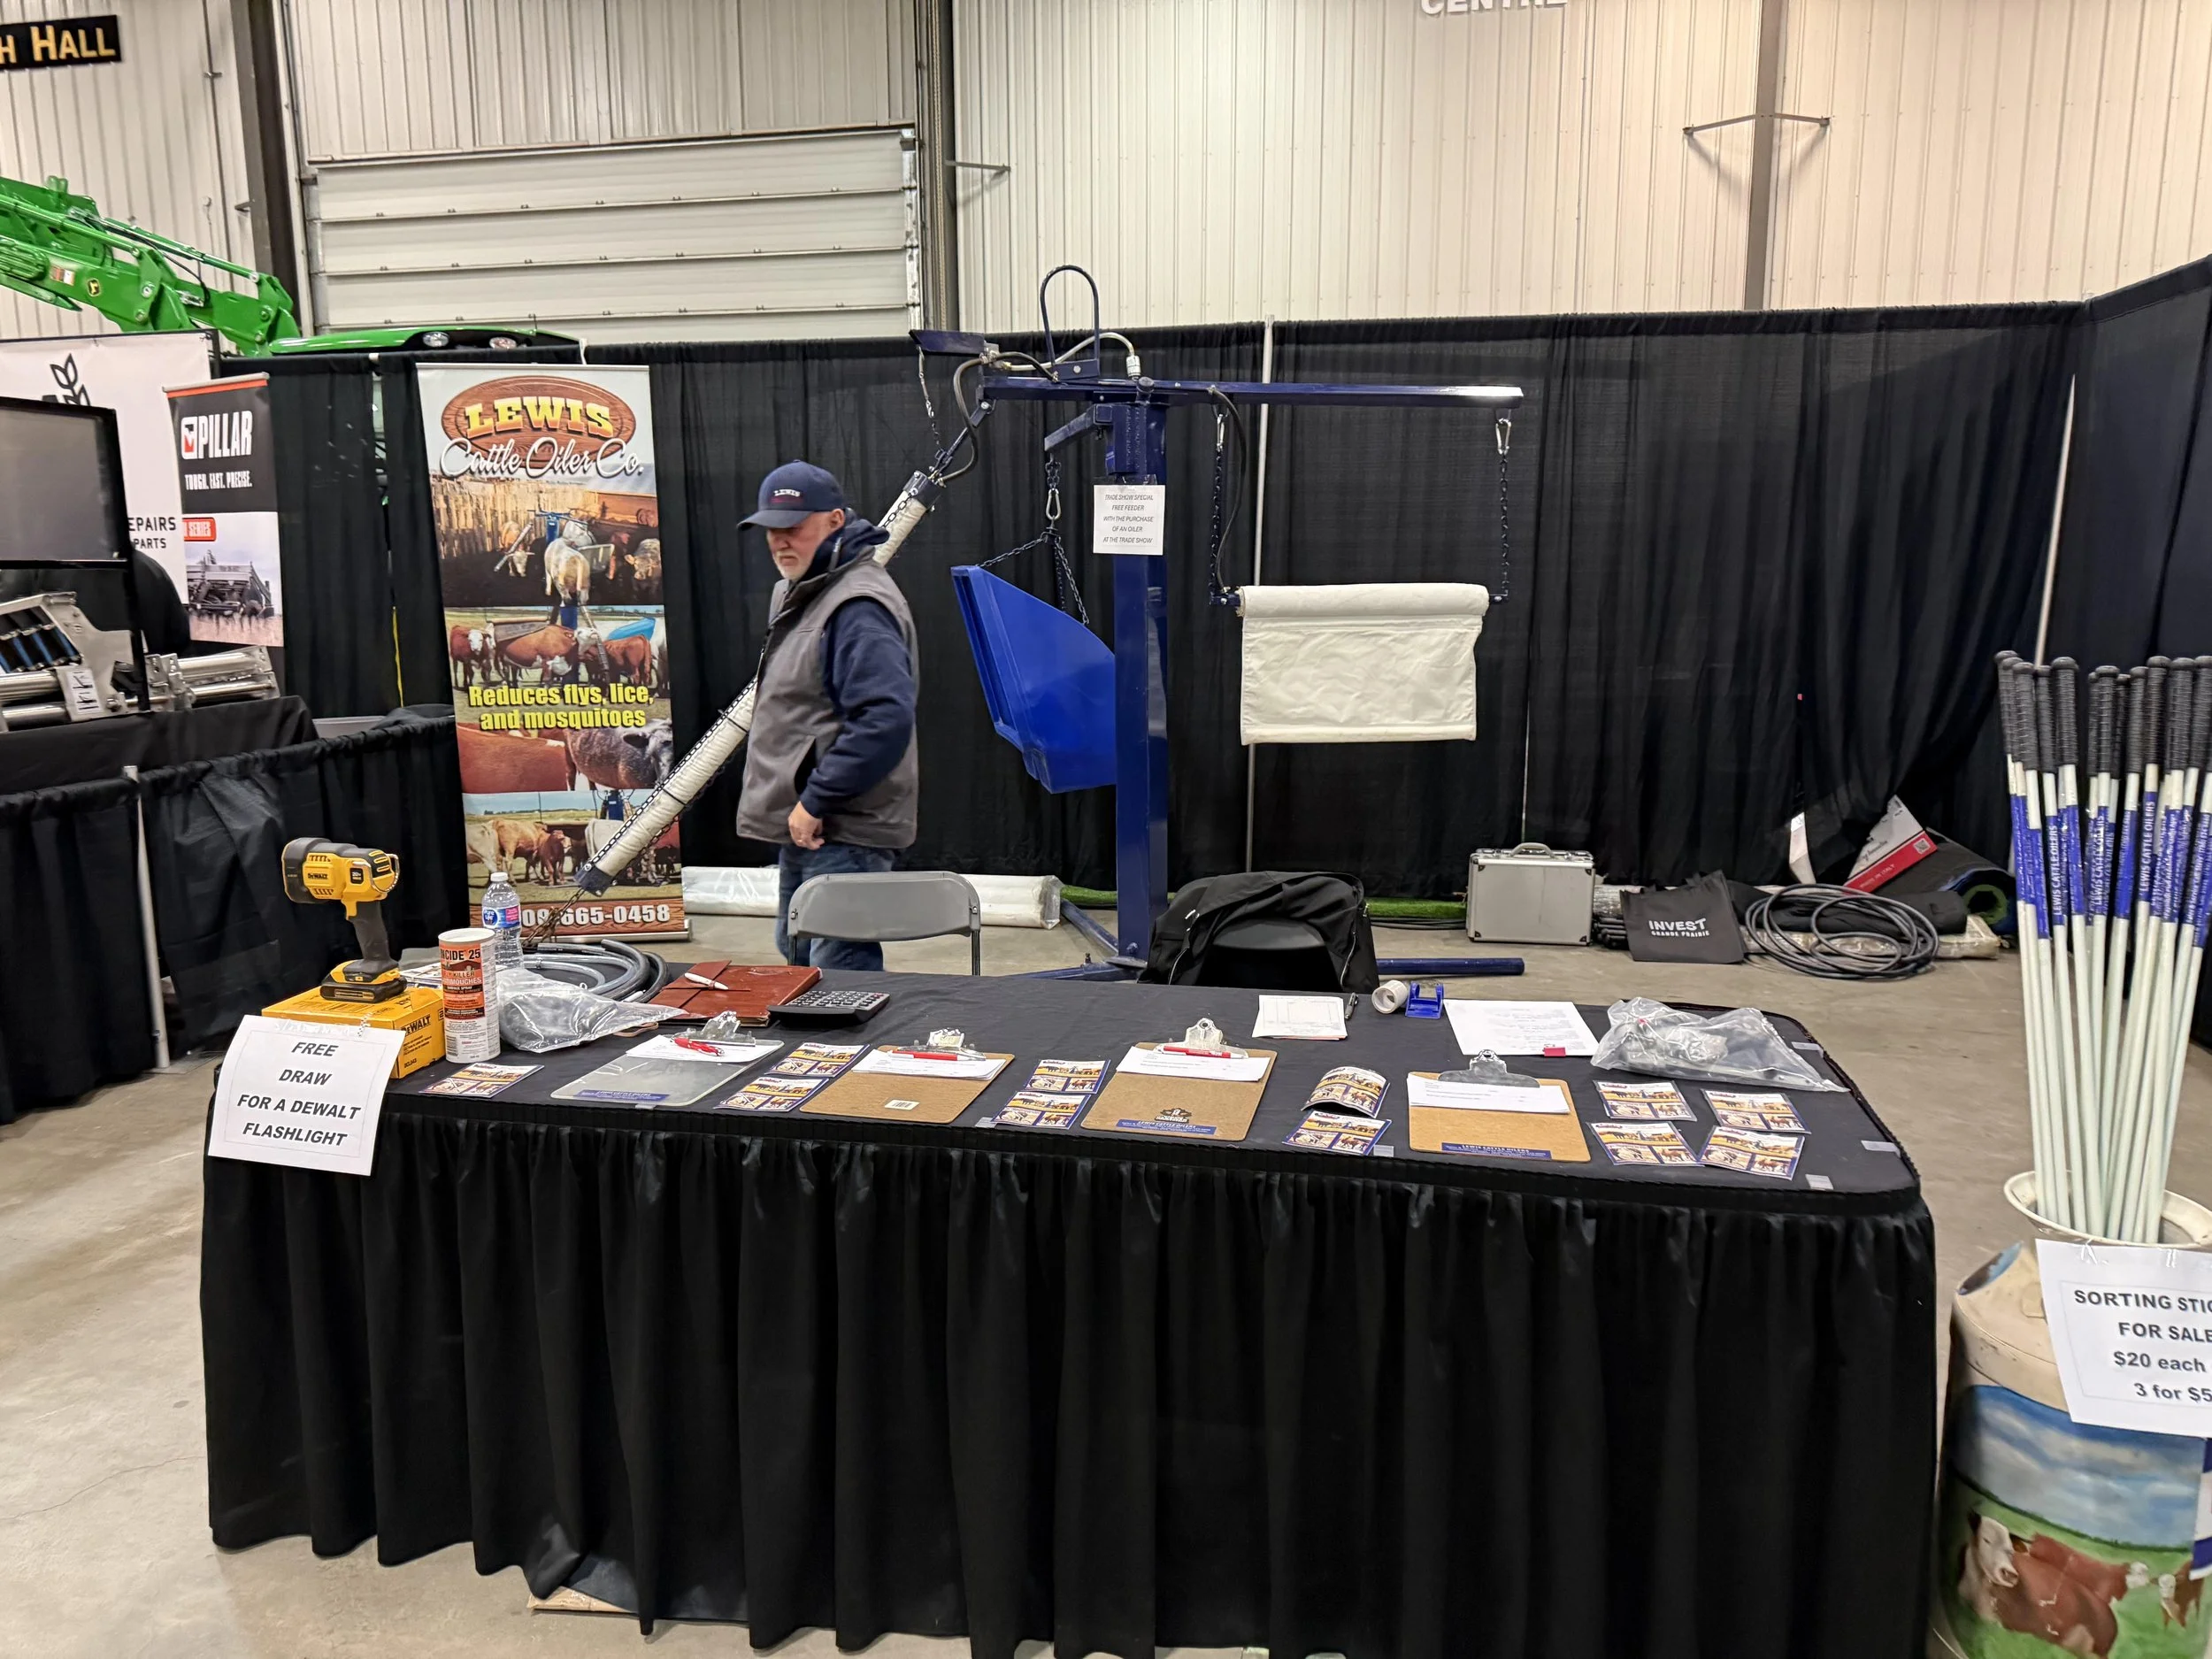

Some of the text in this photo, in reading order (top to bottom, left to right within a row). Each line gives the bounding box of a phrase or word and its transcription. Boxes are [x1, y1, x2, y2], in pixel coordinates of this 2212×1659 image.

[30, 25, 116, 61] HALL
[465, 396, 613, 439] LEWIS
[198, 411, 253, 459] PILLAR
[441, 436, 644, 478] Cattle Oiler Co.
[134, 538, 166, 549] PARTS
[469, 683, 654, 706] Reduces flys, lice,
[480, 708, 646, 730] and mosquitoes
[2139, 801, 2155, 892] LEWIS CATTLE OILERS
[521, 904, 671, 927] 0665-0458
[1648, 918, 1707, 932] INVEST
[468, 949, 481, 960] 25
[291, 1041, 339, 1057] FREE
[278, 1069, 333, 1086] DRAW
[237, 1094, 361, 1120] FOR A DEWALT
[242, 1122, 348, 1147] FLASHLIGHT
[2074, 1289, 2172, 1310] SORTING
[2118, 1322, 2212, 1343] FOR SALE
[2114, 1350, 2152, 1368] $20
[2158, 1358, 2207, 1372] each
[2134, 1383, 2147, 1397] 3
[2153, 1384, 2183, 1401] for
